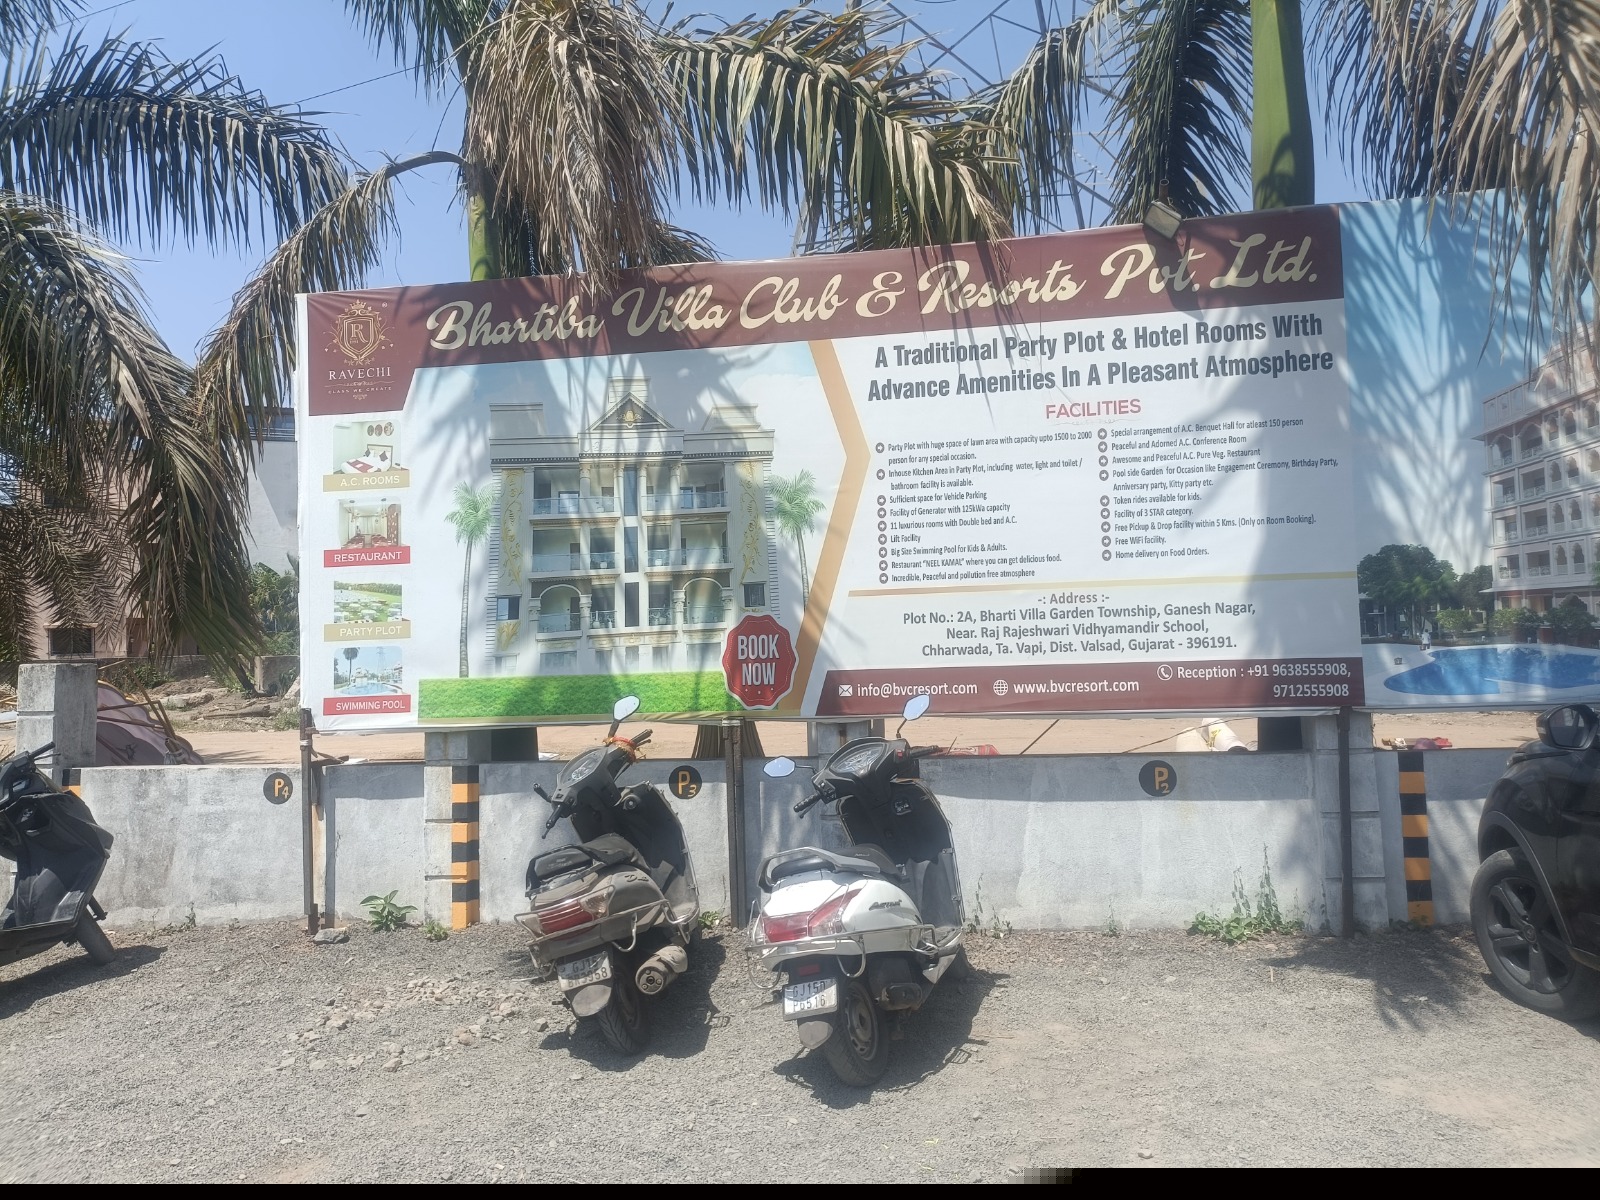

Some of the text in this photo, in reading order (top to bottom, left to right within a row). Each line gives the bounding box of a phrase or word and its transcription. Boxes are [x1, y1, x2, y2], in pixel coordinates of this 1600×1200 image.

[426, 233, 1318, 350] Bhartiba Villa Club & Resorts Pvt. Ltd.
[875, 313, 1322, 368] A Traditional Party Plot & Hotel Rooms With
[329, 366, 391, 380] RAVECHI
[868, 350, 1334, 401] Advance Amenities In A Pleasant Atmosphere
[1045, 398, 1142, 419] FACILITIES
[888, 457, 907, 466] person
[908, 454, 917, 462] for
[929, 452, 949, 463] special
[950, 451, 976, 460] occasion.
[1142, 453, 1154, 462] and
[1155, 451, 1181, 461] Peaceful
[1182, 451, 1195, 459] A.C.
[1211, 450, 1225, 459] Veg.
[1226, 447, 1261, 458] Restaurant
[340, 475, 400, 486] A.C. ROOMS
[890, 478, 973, 490] bathroom facility is available.
[1112, 482, 1149, 491] Anniversary
[1150, 481, 1168, 491] party,
[1168, 479, 1184, 489] Kitty
[1184, 479, 1201, 488] party
[889, 490, 987, 503] Sufficient space for Vehicle Parking
[1114, 507, 1193, 518] Facility of 3 STAR category.
[1114, 523, 1128, 531] Free
[1128, 522, 1149, 532] Pickup
[1150, 521, 1156, 530] &
[1157, 521, 1172, 530] Drop
[1173, 519, 1194, 529] facility
[1194, 519, 1215, 527] within
[1221, 518, 1236, 526] Kms.
[1265, 516, 1284, 524] Room
[1144, 535, 1166, 544] facility.
[334, 551, 402, 562] RESTAURANT
[890, 547, 900, 557] Big
[912, 545, 942, 555] Swimming
[943, 544, 956, 553] Pool
[957, 544, 966, 552] for
[966, 543, 979, 552] Kids
[980, 543, 986, 551] &
[986, 542, 1007, 551] Adults.
[1115, 550, 1133, 558] Home
[1134, 549, 1159, 558] delivery
[1169, 547, 1185, 556] Food
[1186, 546, 1209, 555] Orders.
[965, 557, 984, 565] where
[984, 558, 996, 566] you
[1008, 556, 1018, 565] get
[1018, 554, 1045, 563] delicious
[1046, 553, 1061, 562] food.
[891, 568, 1035, 582] Incredible, Peaceful and pollution free atmosphere
[1049, 592, 1098, 605] Address
[903, 602, 1256, 624] Plot No.: 2A, Bharti Villa Garden Township, Ganesh Nagar,
[340, 626, 402, 637] PARTY PLOT
[946, 619, 1209, 640] Near. Raj Rajeshwari Vidhyamandir School,
[737, 634, 780, 660] BOOK
[922, 643, 993, 656] Chharwada,
[996, 643, 1013, 654] Ta.
[1016, 642, 1047, 655] Vapi,
[1050, 641, 1077, 652] Dist.
[1080, 639, 1125, 653] Valsad,
[1128, 638, 1174, 653] Gujarat
[1186, 636, 1237, 649] 396191.
[742, 662, 776, 686] NOW
[1177, 665, 1236, 680] Reception
[1247, 664, 1269, 677] +91
[1272, 663, 1351, 678] 9638555908,
[857, 681, 978, 698] info@bvcresort.com
[1013, 680, 1140, 694] www.bvcresort.com
[1273, 684, 1349, 697] 9712555908
[336, 700, 405, 711] SWIMMING POOL
[678, 770, 697, 797] P3
[1154, 767, 1170, 794] P2
[274, 778, 289, 799] P4
